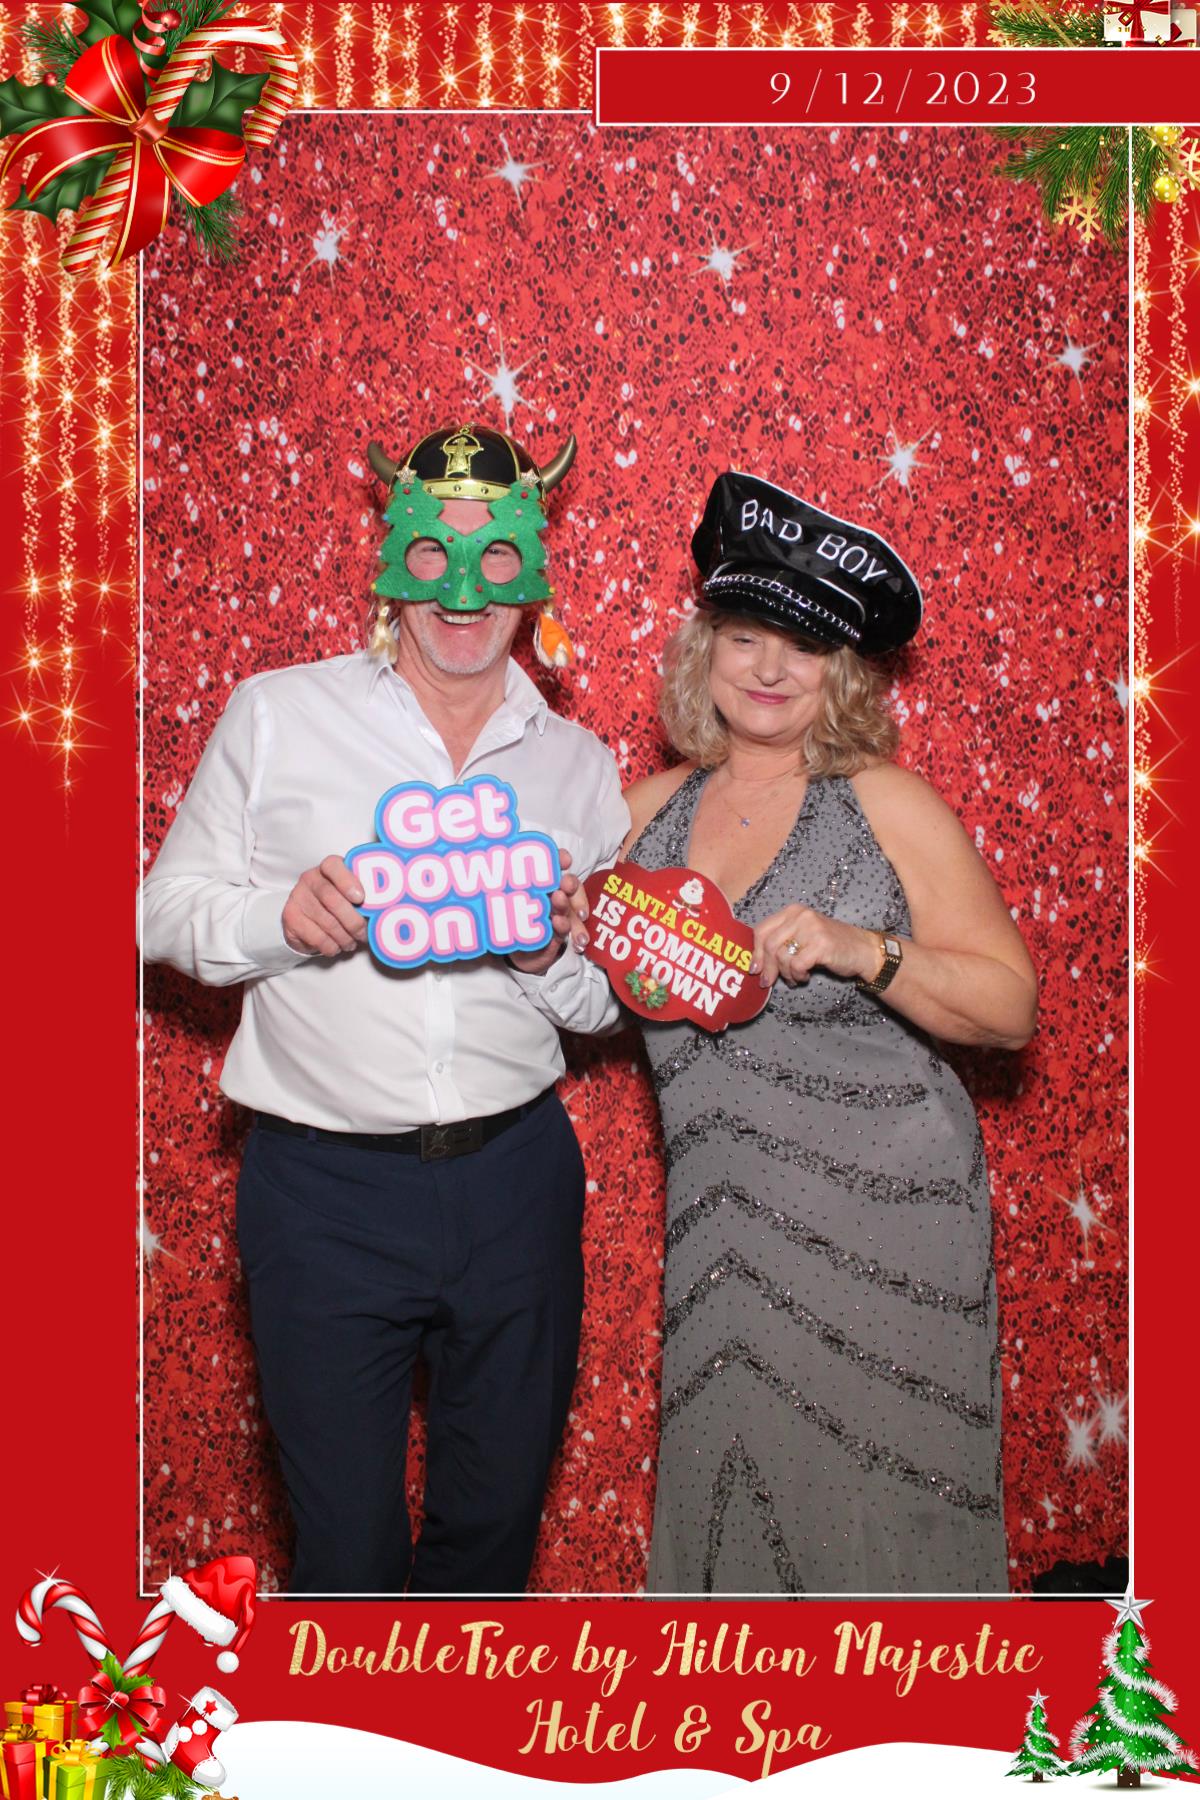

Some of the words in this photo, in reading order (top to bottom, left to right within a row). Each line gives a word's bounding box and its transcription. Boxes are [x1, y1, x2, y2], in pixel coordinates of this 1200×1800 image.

[741, 499, 803, 543] BAD
[816, 533, 888, 582] BOY
[388, 787, 507, 845] Get
[357, 844, 550, 905] Down
[380, 906, 474, 957] On
[490, 894, 542, 943] It
[592, 893, 627, 927] IS
[626, 914, 745, 999] COMING
[603, 874, 678, 930] SANTA
[681, 918, 754, 974] CLAUS
[593, 923, 632, 961] TO
[634, 946, 724, 1017] TOWN
